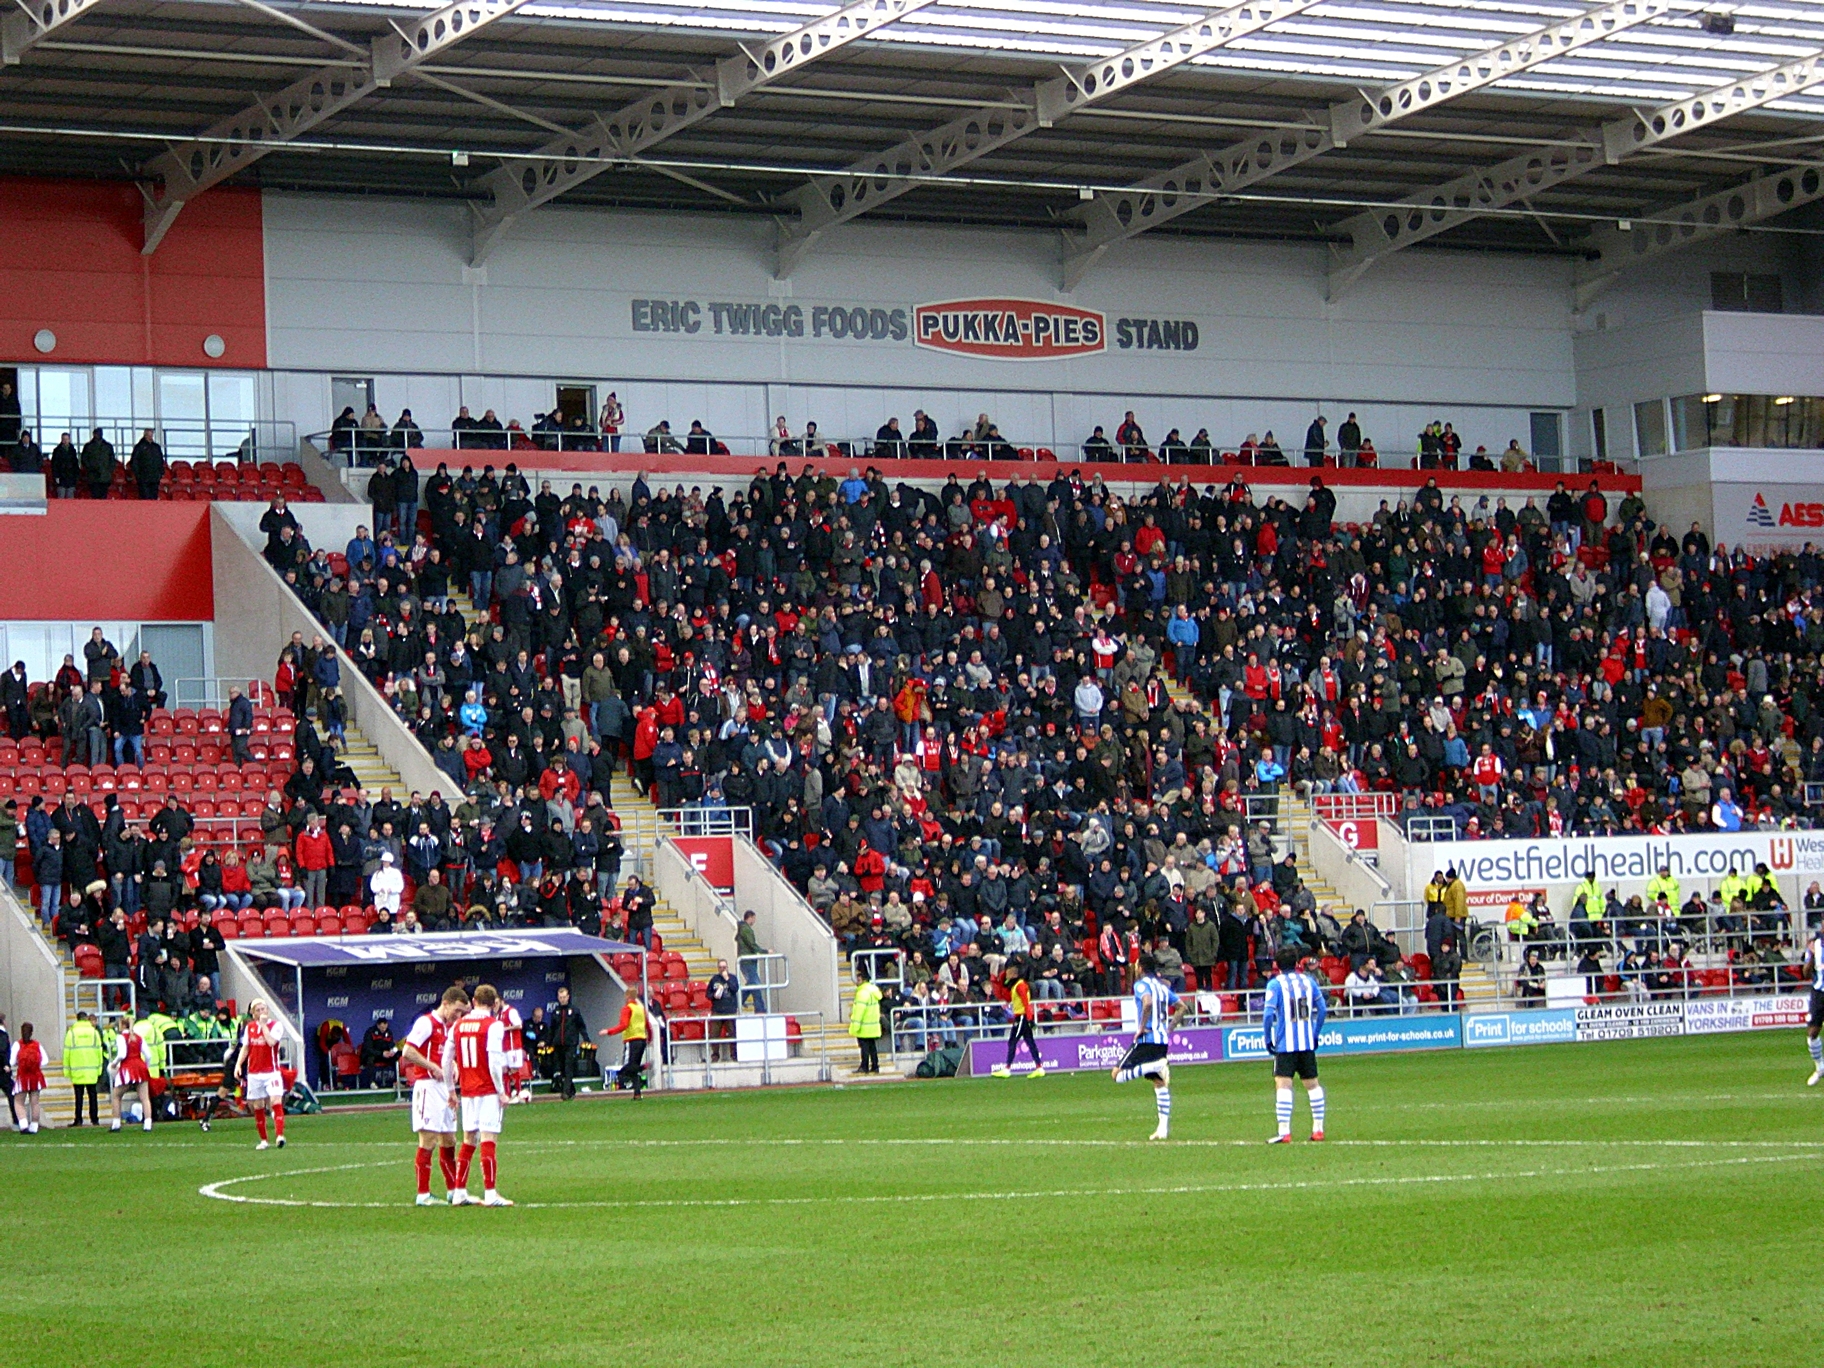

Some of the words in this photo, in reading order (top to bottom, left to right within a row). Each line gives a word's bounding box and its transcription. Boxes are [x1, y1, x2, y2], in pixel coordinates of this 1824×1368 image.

[632, 299, 701, 333] ERIC
[708, 302, 804, 337] TWIGG
[812, 306, 907, 341] FOODS
[921, 312, 1100, 345] PUKKA-PIES
[1117, 318, 1199, 350] STAND
[1779, 503, 1824, 527] AES
[1339, 822, 1358, 848] G
[1795, 838, 1824, 852] Wes
[691, 853, 707, 870] E
[1448, 841, 1756, 882] westfieldhealth.com
[326, 967, 348, 977] KCM
[415, 963, 435, 973] KCM
[502, 960, 522, 970] KCM
[462, 975, 480, 985] CM
[545, 972, 565, 982] KCM
[371, 979, 393, 990] KCM
[416, 993, 437, 1004] KCM
[503, 989, 524, 999] KCM
[327, 997, 349, 1008] KCM
[547, 1002, 559, 1013] KC
[1686, 1003, 1714, 1015] VANS
[1717, 1002, 1728, 1014] IN
[1753, 1001, 1773, 1011] THE
[1776, 999, 1804, 1010] USED
[372, 1009, 394, 1020] KCM
[1577, 1009, 1612, 1020] GLEAM
[1615, 1006, 1644, 1018] OVEN
[1647, 1004, 1680, 1016] CLEAN
[1475, 1022, 1502, 1037] Print
[1511, 1021, 1527, 1035] for
[1529, 1018, 1573, 1033] schools
[1688, 1015, 1749, 1030] YORKSHIRE
[1347, 1028, 1454, 1044] www.print-for-schools.co.uk
[1580, 1030, 1594, 1039] Tel
[1598, 1028, 1633, 1039] 01709
[1638, 1025, 1680, 1036] 519203
[1237, 1035, 1266, 1050] Print
[1317, 1031, 1343, 1046] ools
[460, 1037, 478, 1068] 11
[1078, 1044, 1123, 1061] Parkgate
[1166, 1051, 1208, 1061] shopping.co.uk
